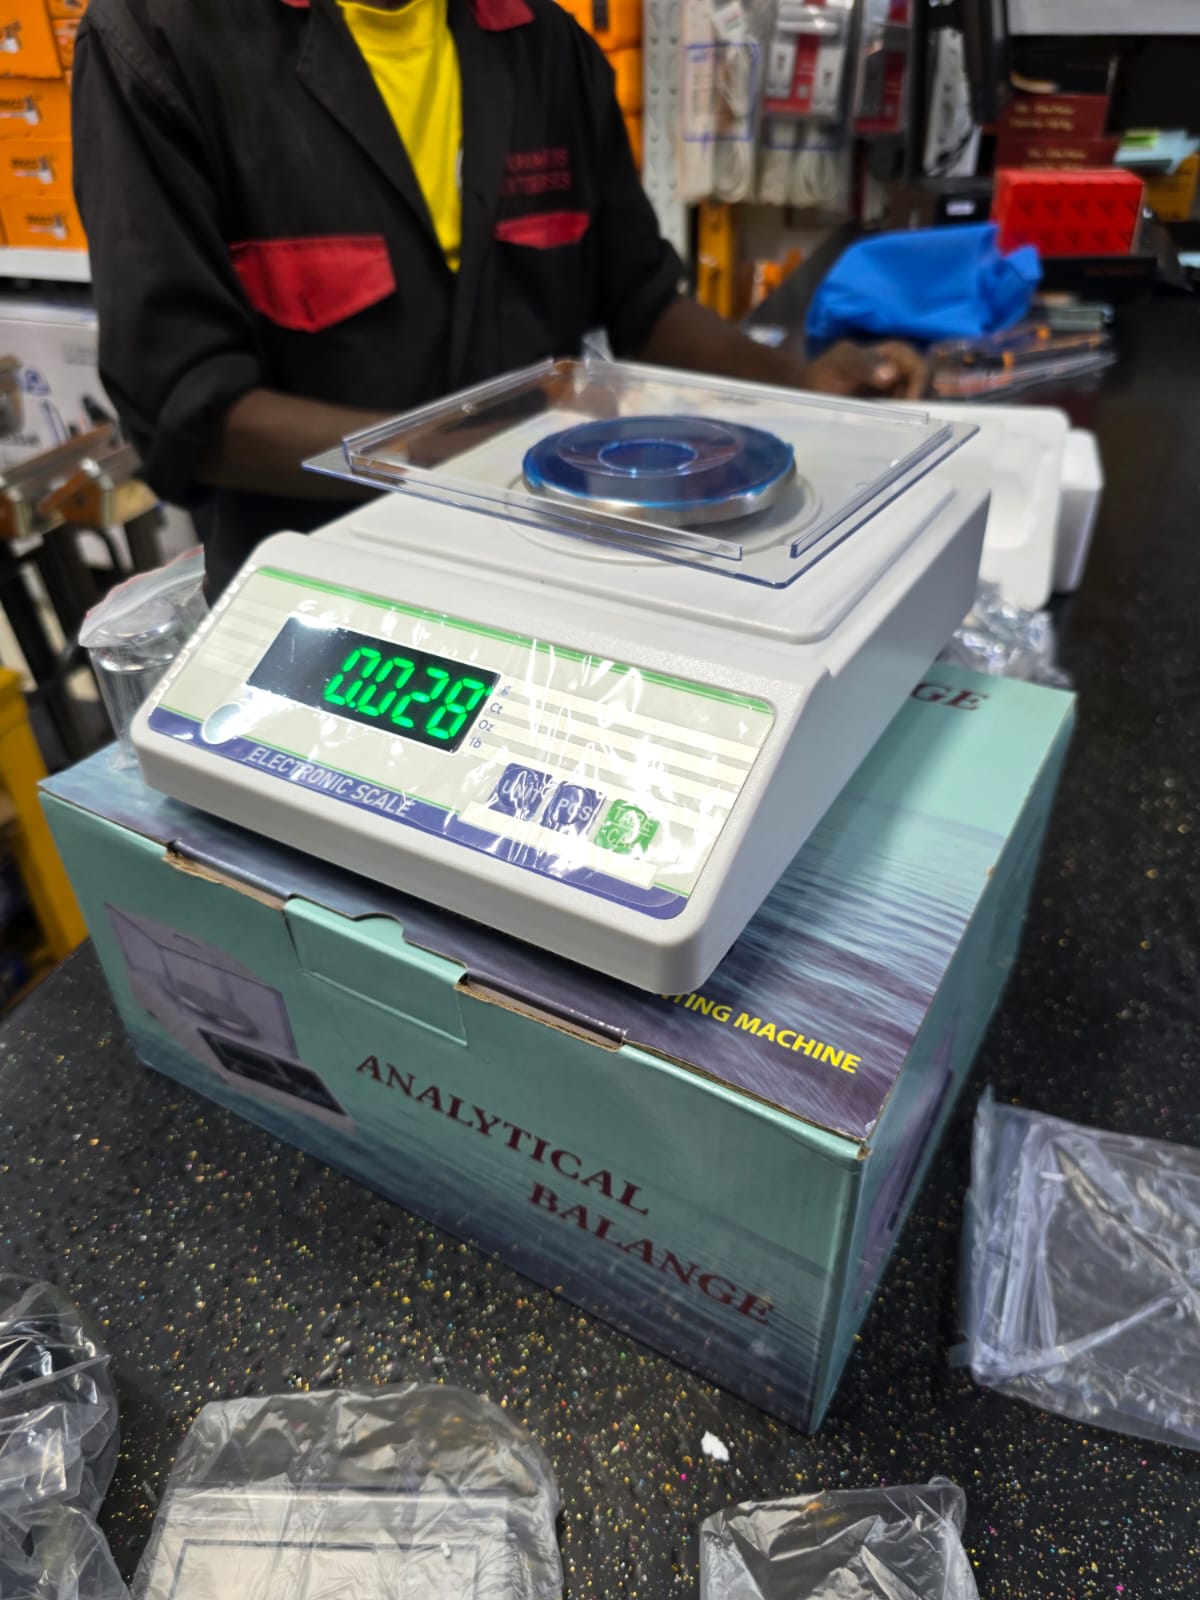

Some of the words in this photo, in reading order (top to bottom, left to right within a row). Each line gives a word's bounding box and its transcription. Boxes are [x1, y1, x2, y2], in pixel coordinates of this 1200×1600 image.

[323, 646, 486, 740] 0.028
[489, 702, 503, 715] Ct
[500, 685, 511, 697] g
[478, 719, 495, 732] Oz
[247, 747, 353, 794] ELECTRONIC
[351, 784, 412, 817] SCALE
[555, 798, 593, 821] PCS
[733, 1011, 862, 1074] MACHINE
[356, 1054, 650, 1216] ANALYTICAL
[528, 1181, 776, 1326] BALANGE
